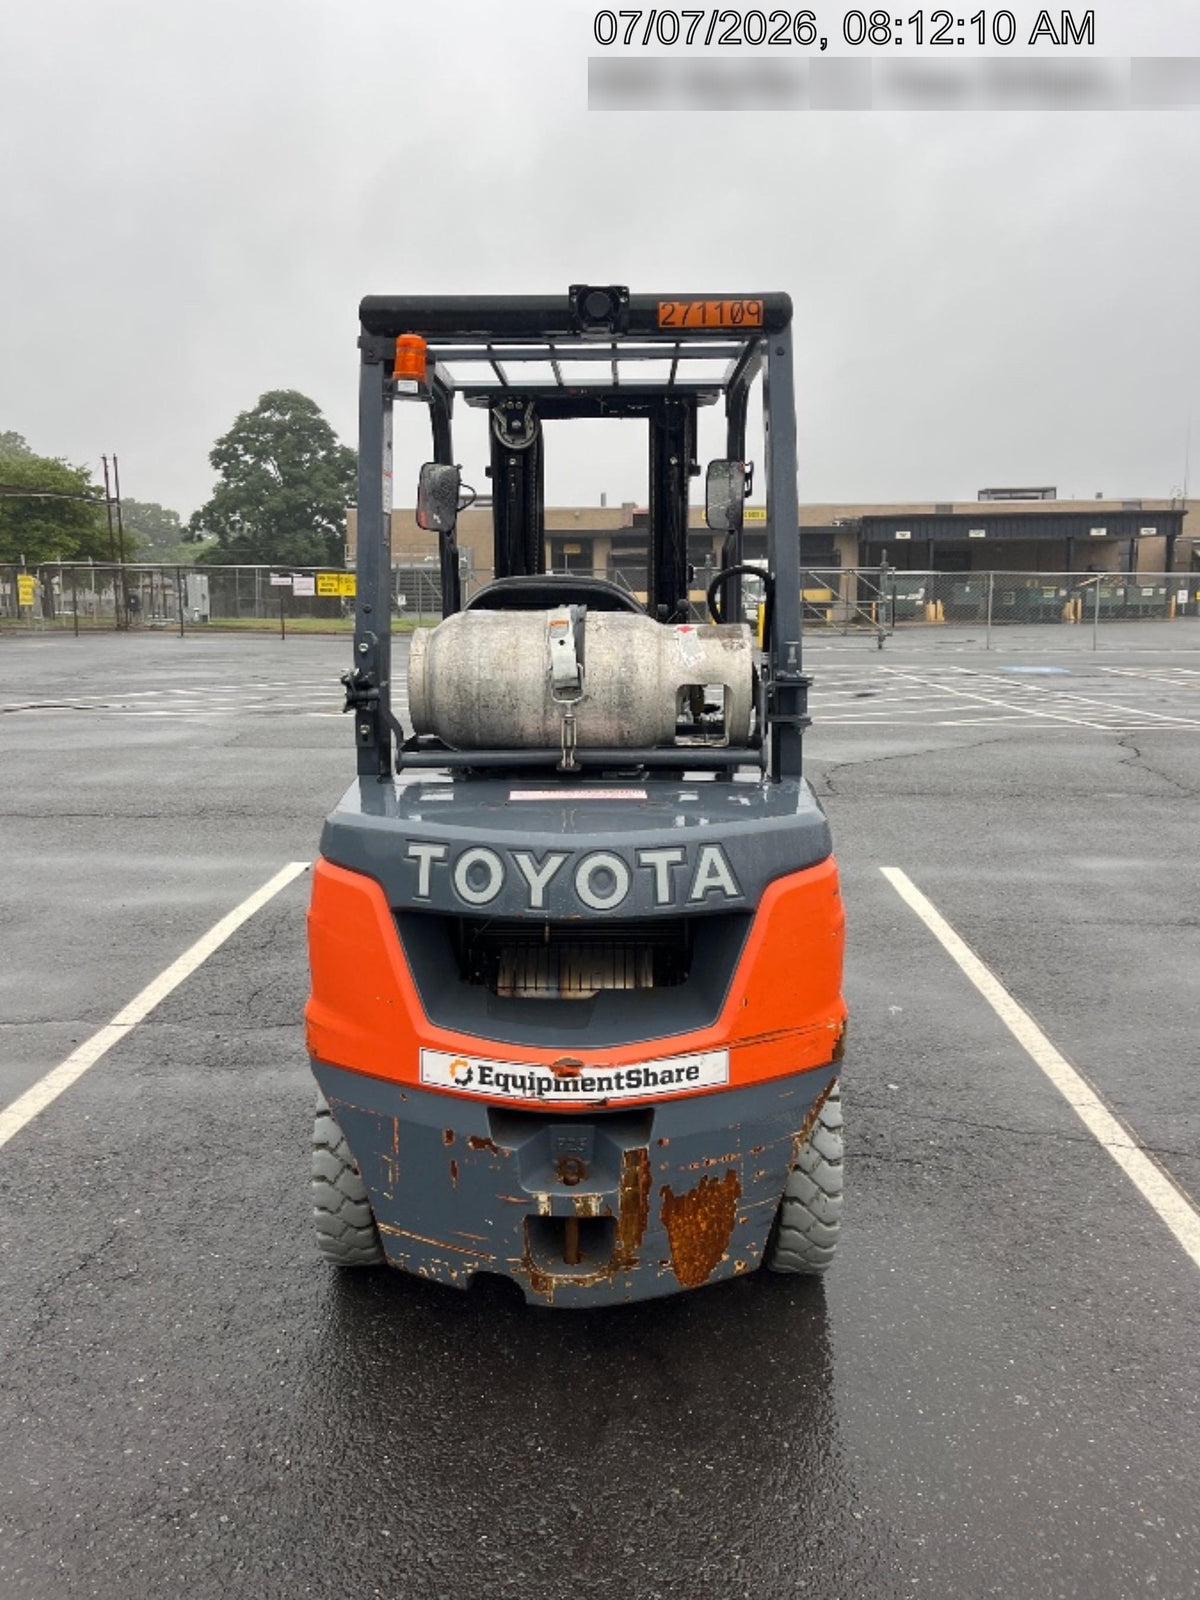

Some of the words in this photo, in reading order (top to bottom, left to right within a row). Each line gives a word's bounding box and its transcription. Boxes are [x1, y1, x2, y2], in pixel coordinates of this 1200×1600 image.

[660, 301, 761, 326] 271109
[406, 842, 740, 911] TOYOTA
[477, 1064, 700, 1097] EquipmentShare
